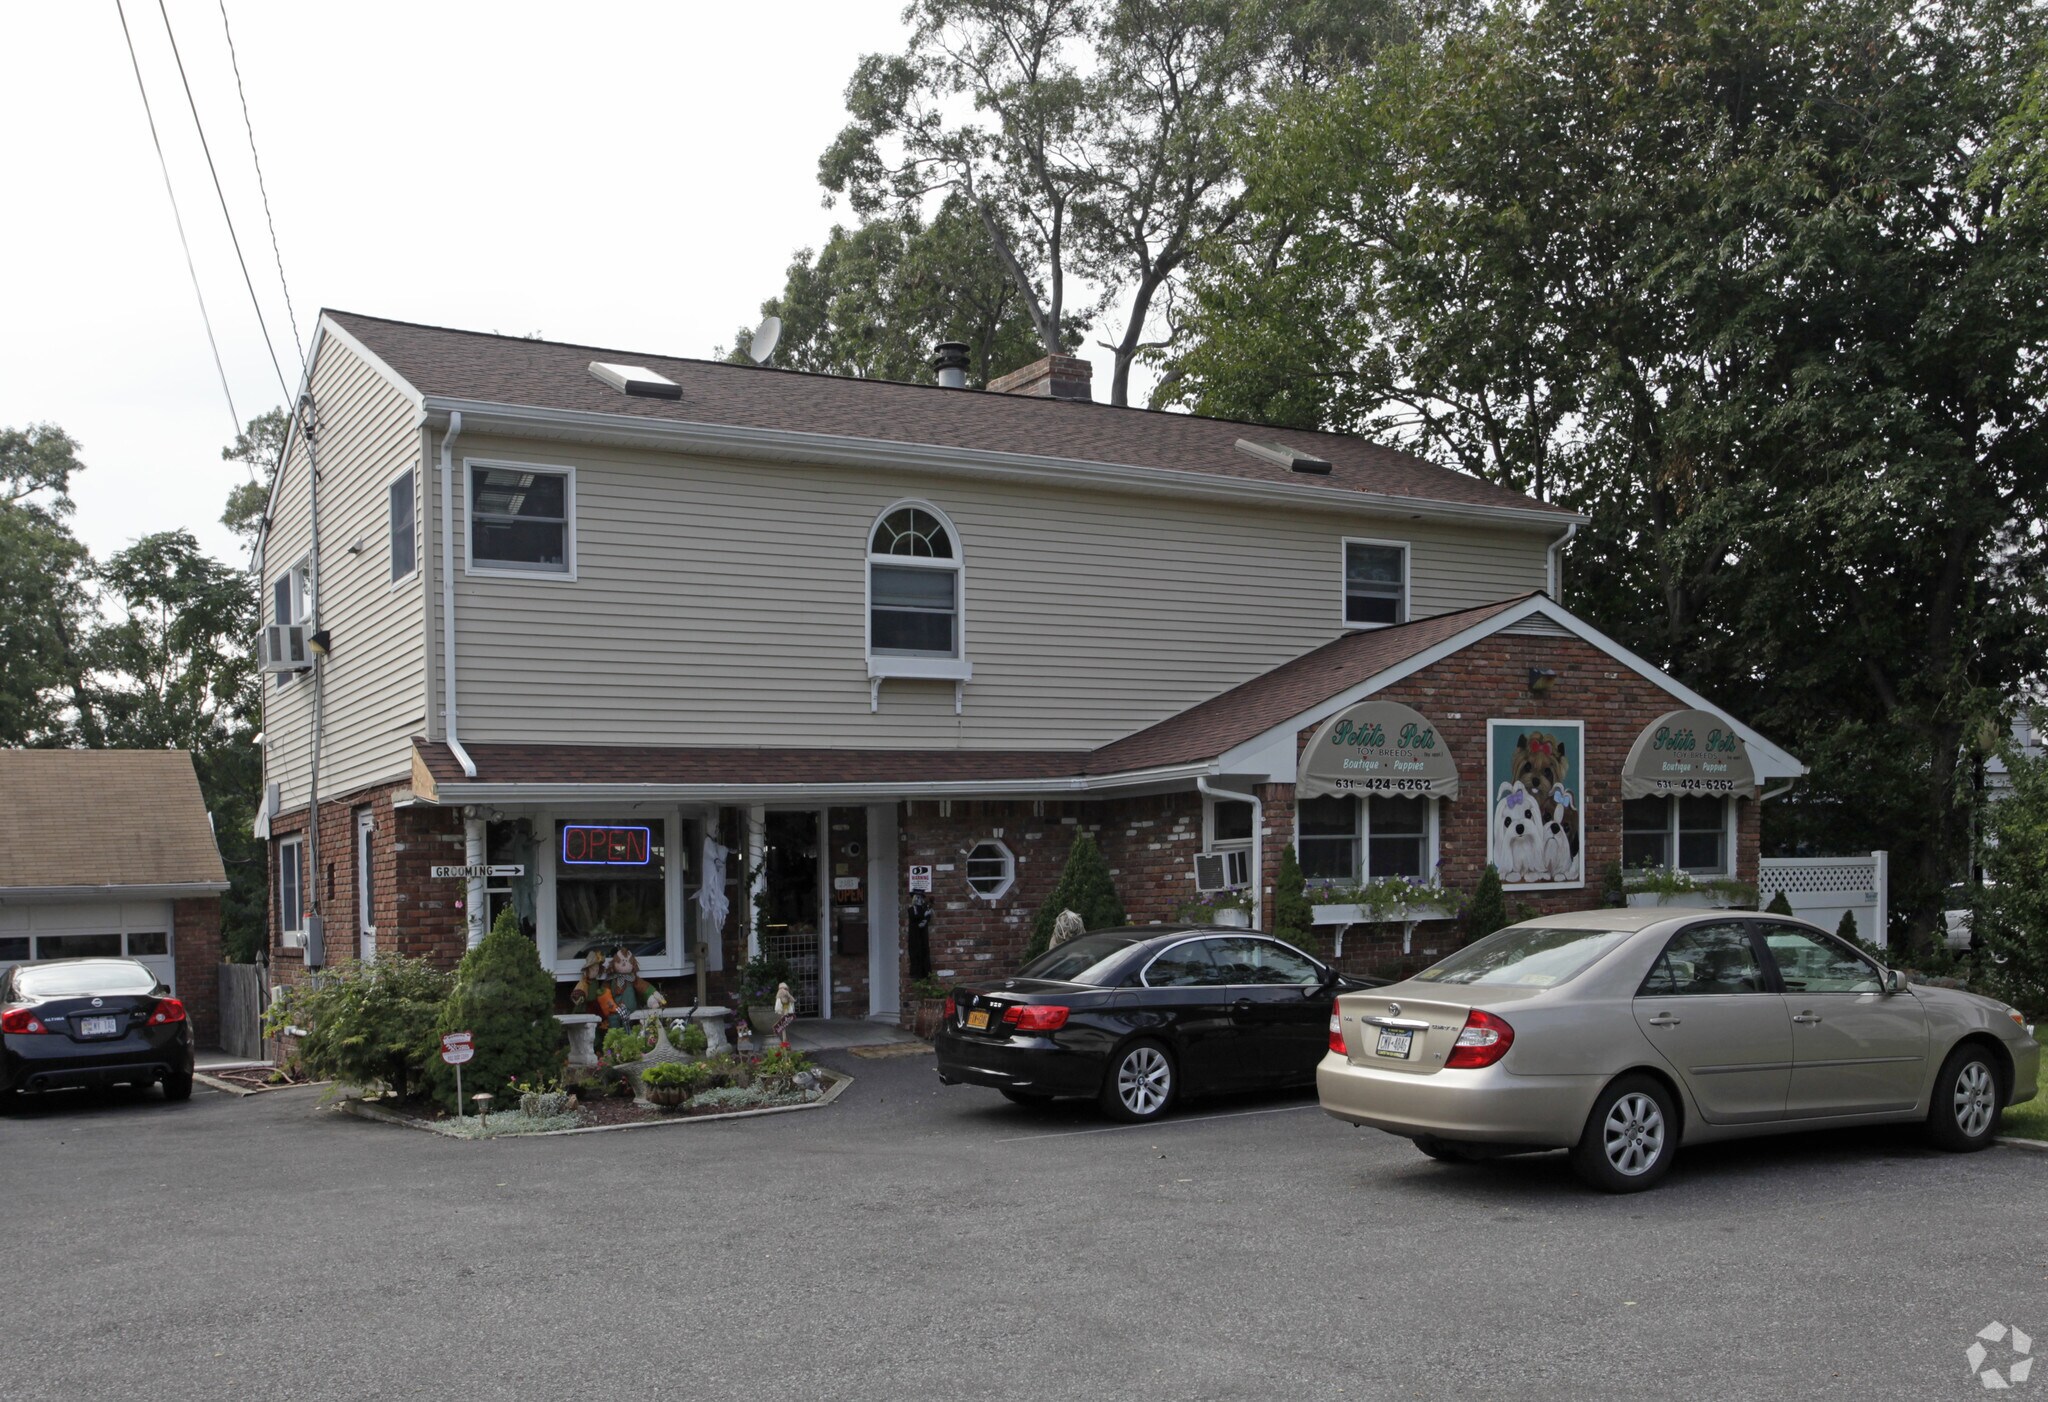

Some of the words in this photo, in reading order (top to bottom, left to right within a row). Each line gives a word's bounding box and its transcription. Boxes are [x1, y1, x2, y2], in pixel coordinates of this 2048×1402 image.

[1332, 719, 1386, 747] Petite
[1653, 727, 1696, 750] Petite
[1379, 749, 1412, 757] BREEDS
[1690, 752, 1717, 760] BREEDS
[1343, 758, 1379, 771] Boutique
[1393, 760, 1424, 771] Puppies
[1662, 761, 1691, 773] Boutique
[1702, 761, 1728, 773] Puppies
[566, 829, 647, 861] OPEN
[436, 866, 493, 877] GROOMING
[837, 889, 864, 902] OPEN
